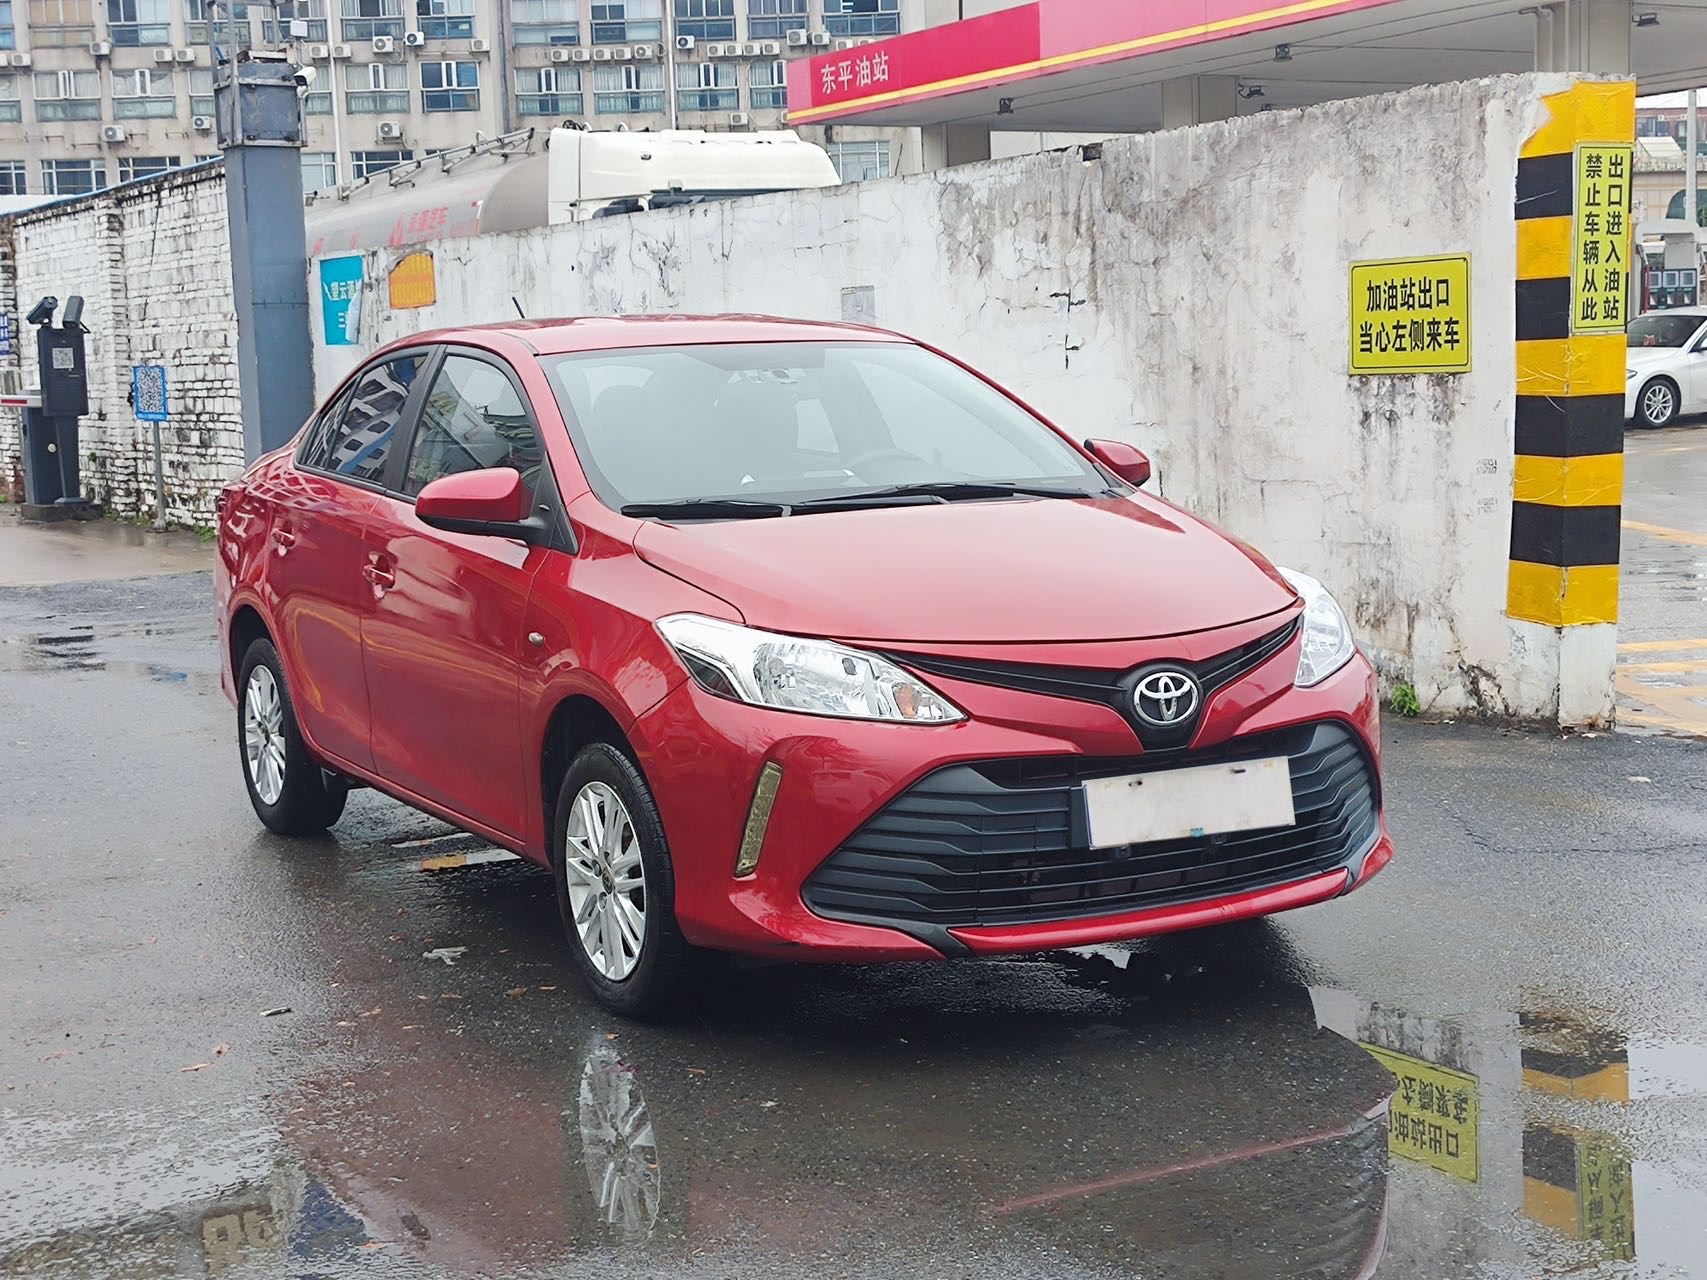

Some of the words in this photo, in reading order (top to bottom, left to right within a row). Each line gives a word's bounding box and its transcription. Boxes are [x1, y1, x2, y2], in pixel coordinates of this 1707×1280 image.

[821, 50, 890, 94] 东平油站
[1581, 153, 1603, 321] 禁止车辆从此
[1603, 153, 1624, 320] 出口进入油站
[1367, 277, 1449, 312] 加油站出口
[1360, 317, 1460, 354] 当心左侧来车
